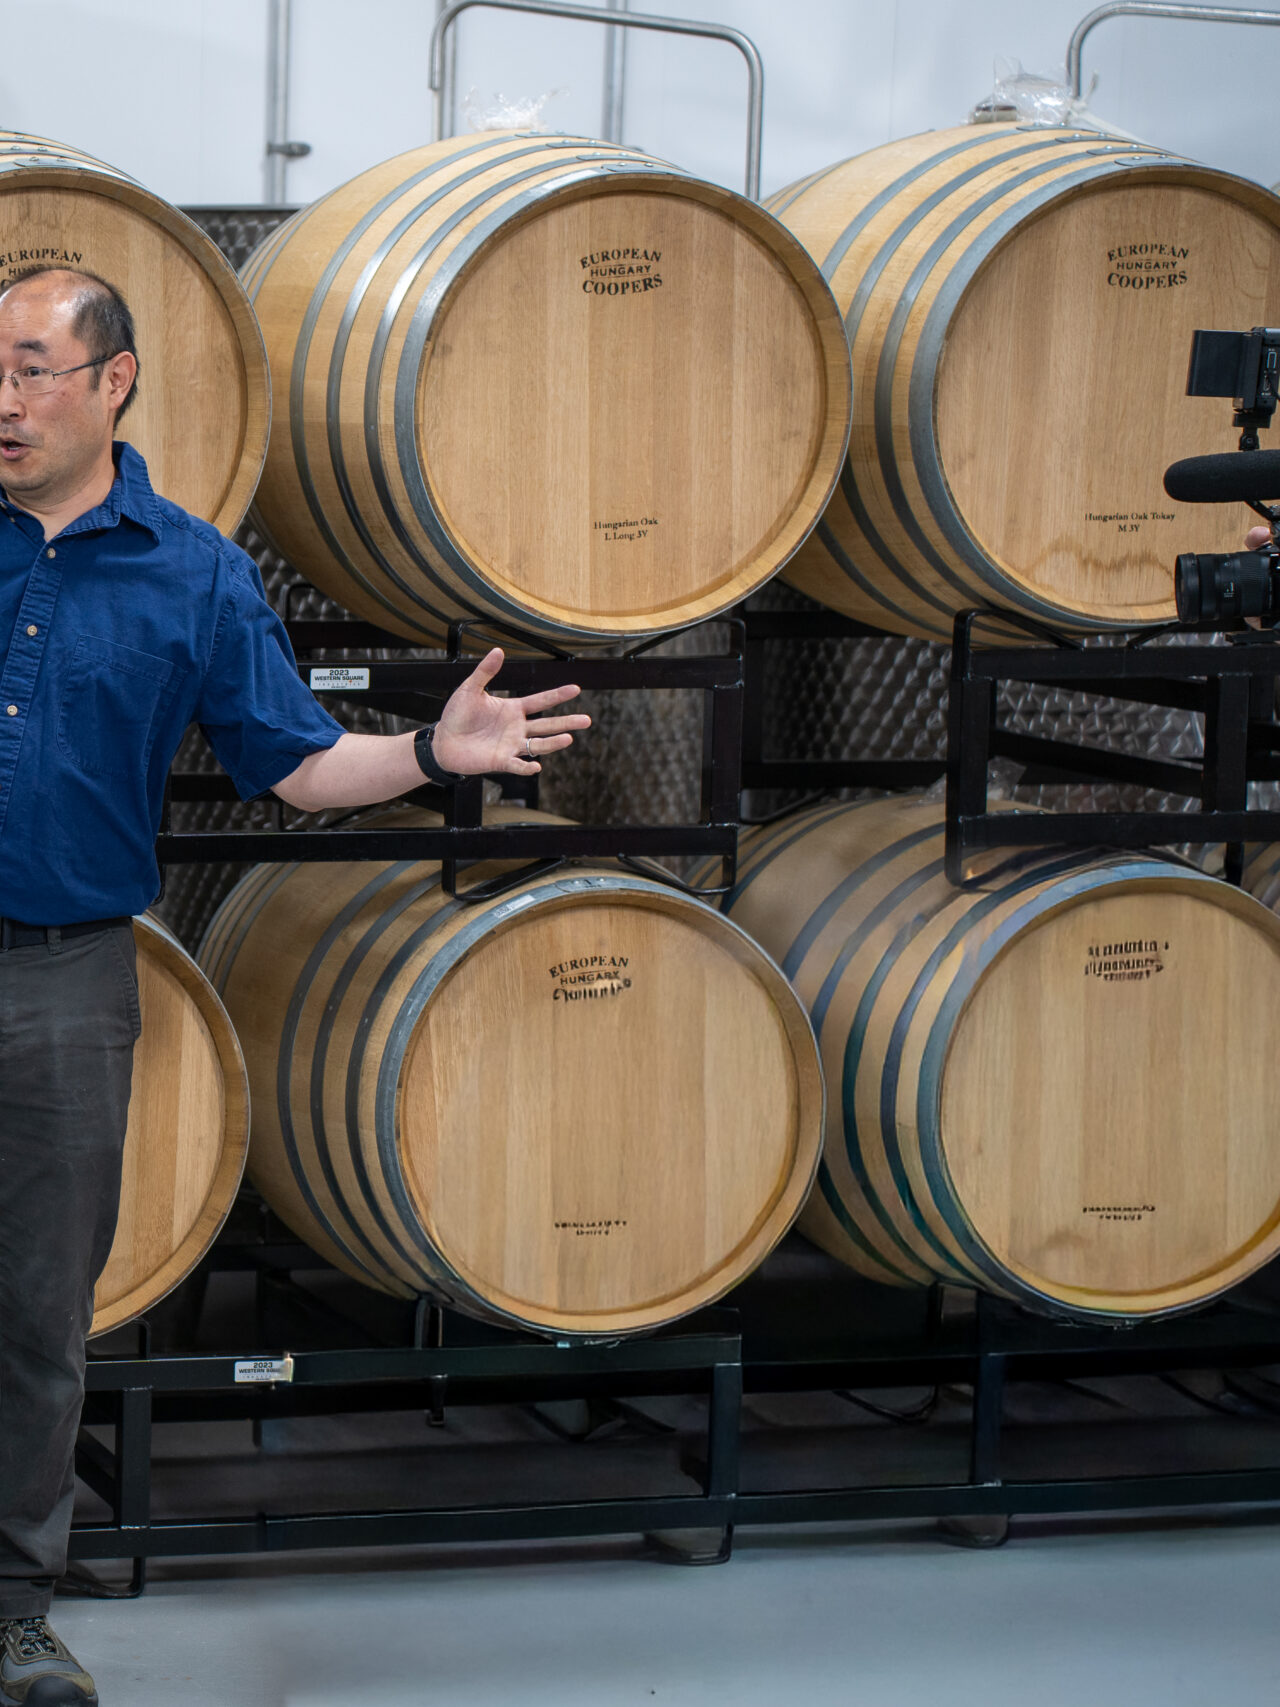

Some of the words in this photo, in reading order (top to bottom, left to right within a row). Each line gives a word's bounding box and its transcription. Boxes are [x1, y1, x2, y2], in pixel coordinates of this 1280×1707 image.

[580, 248, 662, 269] EUROPEAN
[1107, 244, 1189, 262] EUROPEAN
[590, 265, 651, 276] HUNGARY
[1117, 261, 1177, 270] HUNGARY
[582, 274, 663, 295] COOPERS
[1107, 270, 1188, 290] COOPERS
[593, 519, 639, 531] Hungarian
[640, 516, 660, 526] Oak
[1083, 511, 1129, 523] Hungarian
[1130, 511, 1149, 521] Oak
[1150, 511, 1176, 523] Tokay
[637, 529, 649, 539] 3Y
[1118, 523, 1128, 533] M
[1128, 523, 1140, 533] 3Y
[549, 955, 629, 979] EUROPEAN
[560, 971, 620, 985] HUNGARY
[253, 1361, 273, 1369] 2023
